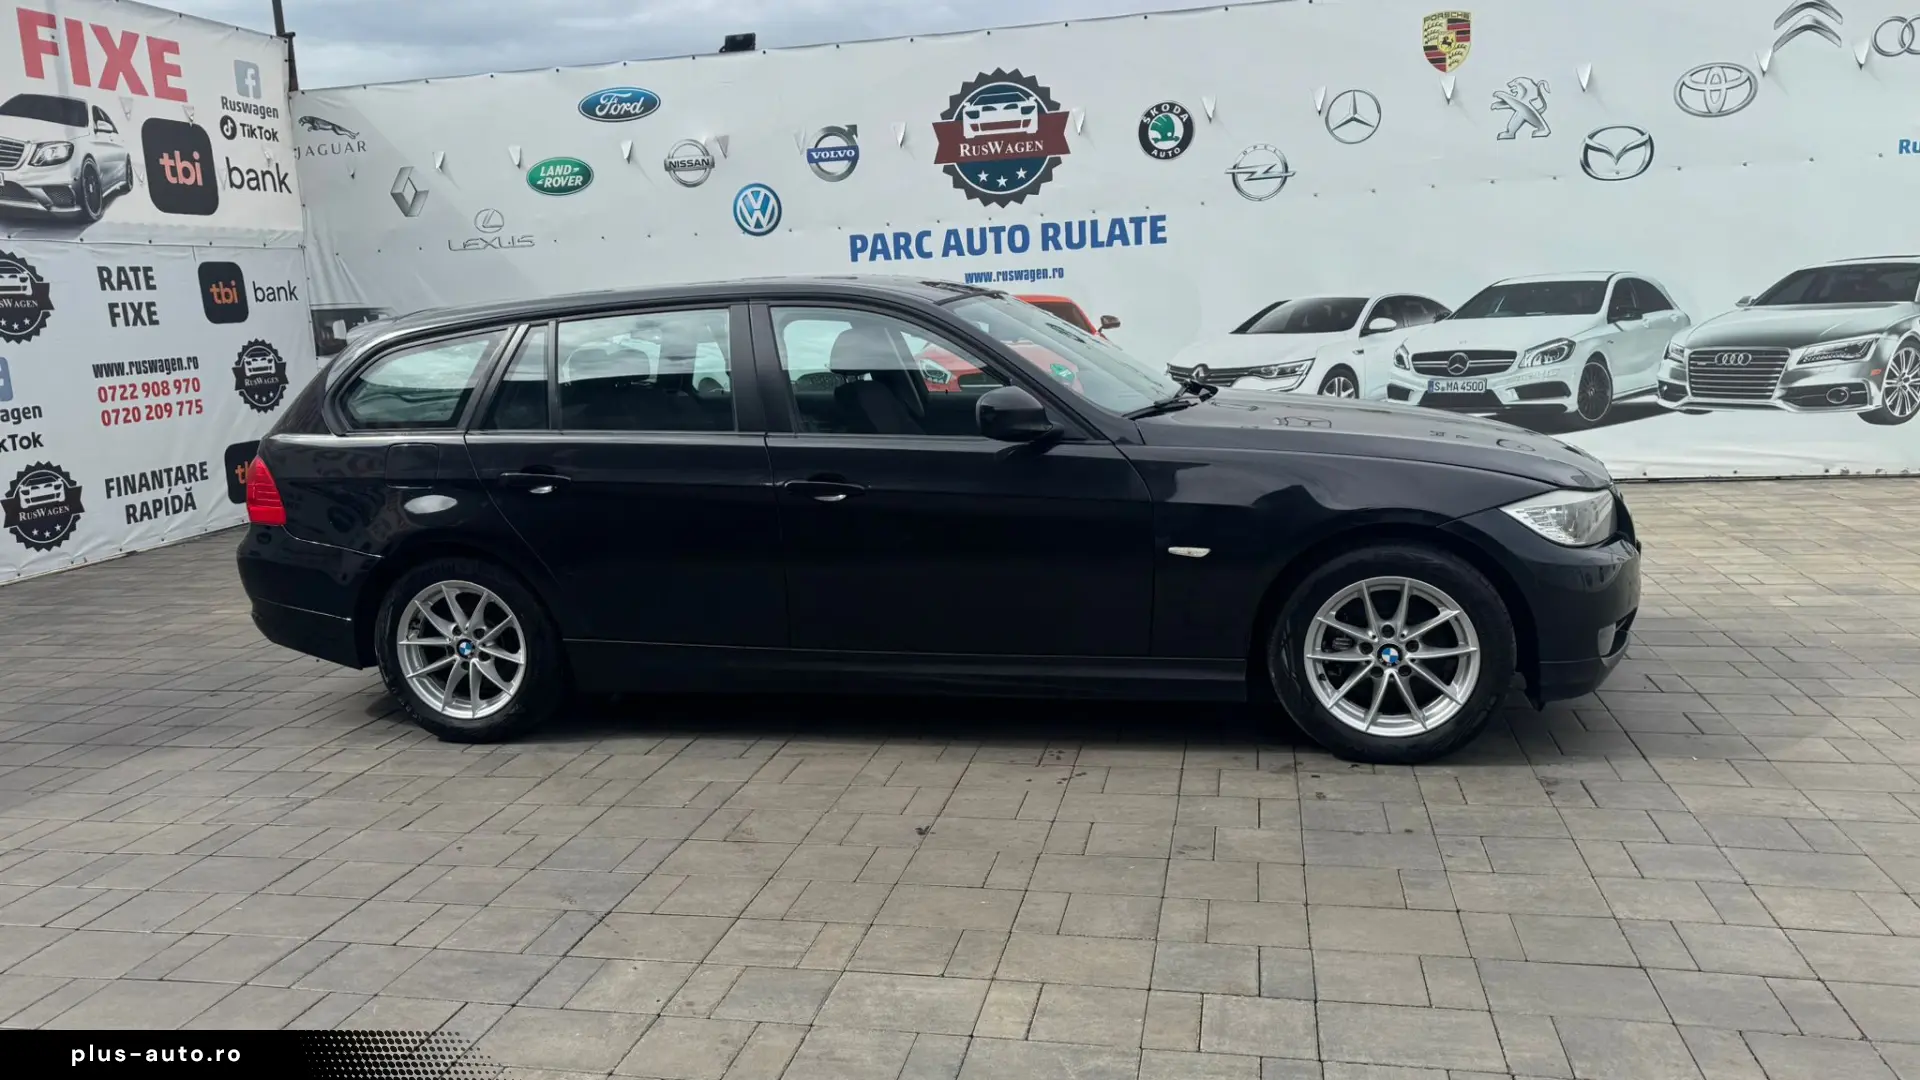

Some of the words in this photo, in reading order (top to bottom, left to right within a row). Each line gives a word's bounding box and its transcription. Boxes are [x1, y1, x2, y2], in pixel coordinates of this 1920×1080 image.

[16, 7, 188, 103] FIXE
[221, 96, 279, 119] Ruswagen
[596, 92, 647, 116] Ford
[240, 122, 279, 142] TikTok
[297, 140, 367, 160] JAGUAR
[811, 147, 856, 160] VOLVO
[1151, 147, 1181, 158] AUTO
[159, 150, 203, 186] tbi
[225, 157, 293, 194] bank
[669, 158, 710, 168] NISSAN
[448, 235, 535, 251] LEXUS
[849, 230, 932, 262] PARC
[941, 223, 1030, 258] AUTO
[1040, 214, 1168, 252] RULATE
[97, 266, 157, 291] RATE
[965, 267, 1064, 284] www.ruswagen.ro
[209, 280, 240, 305] tbi
[252, 280, 299, 303] bank
[108, 301, 160, 328] FIXE
[92, 356, 199, 378] www.ruswagen.ro
[98, 383, 139, 403] 0722
[141, 380, 171, 398] 908
[173, 377, 201, 395] 970
[1460, 381, 1484, 391] 4500
[101, 406, 141, 426] 0720
[145, 402, 173, 421] 209
[176, 398, 203, 417] 775
